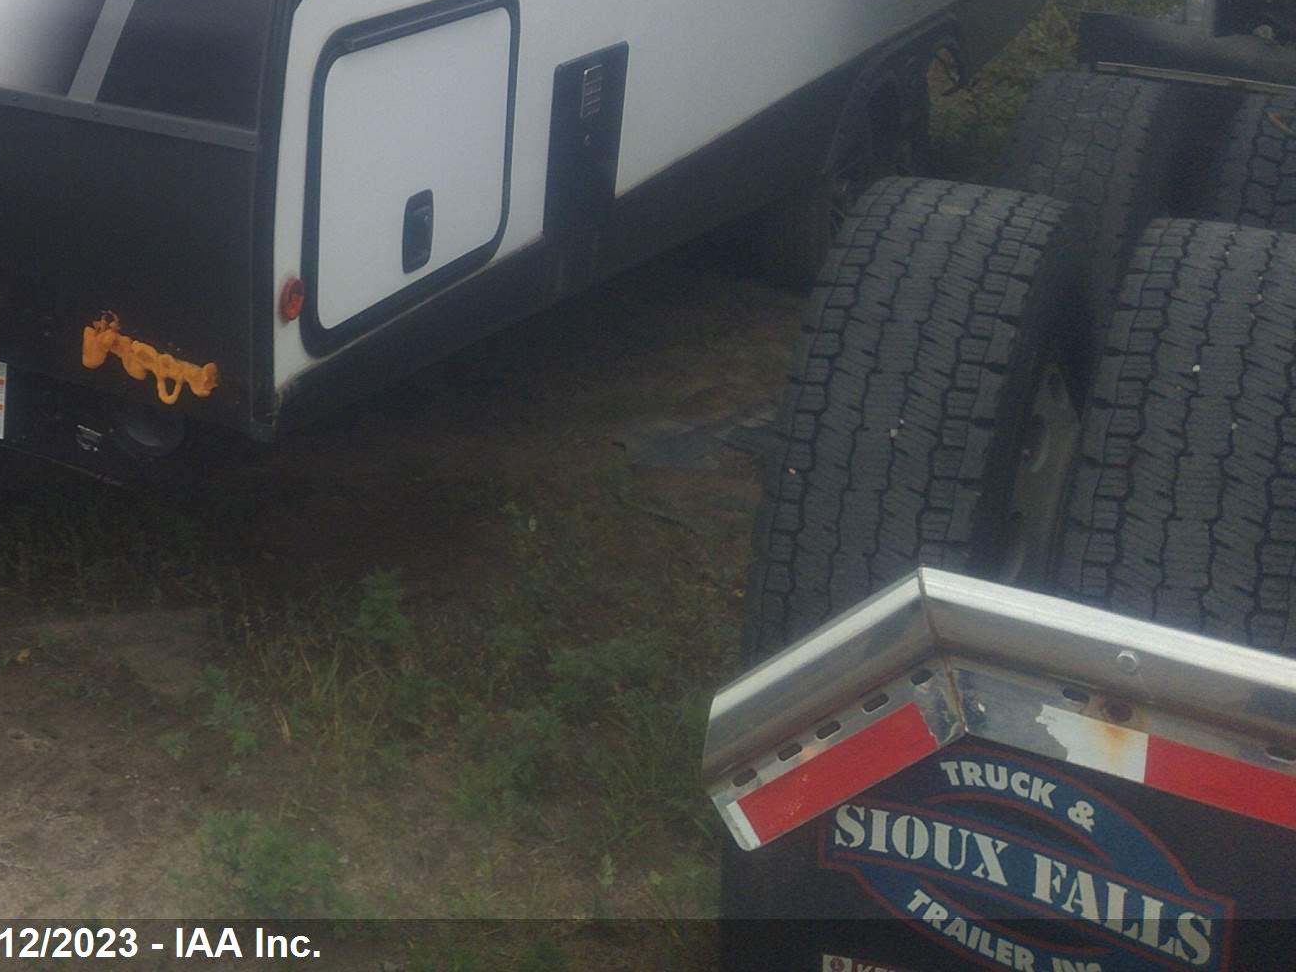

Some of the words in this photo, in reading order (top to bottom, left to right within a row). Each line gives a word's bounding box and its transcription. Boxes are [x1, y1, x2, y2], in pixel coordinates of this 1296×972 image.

[940, 760, 1057, 808] TRUCK
[1067, 799, 1096, 833] &
[834, 804, 1009, 887] SIOUX
[1032, 852, 1213, 966] FALLS
[906, 889, 1036, 972] TRAILER
